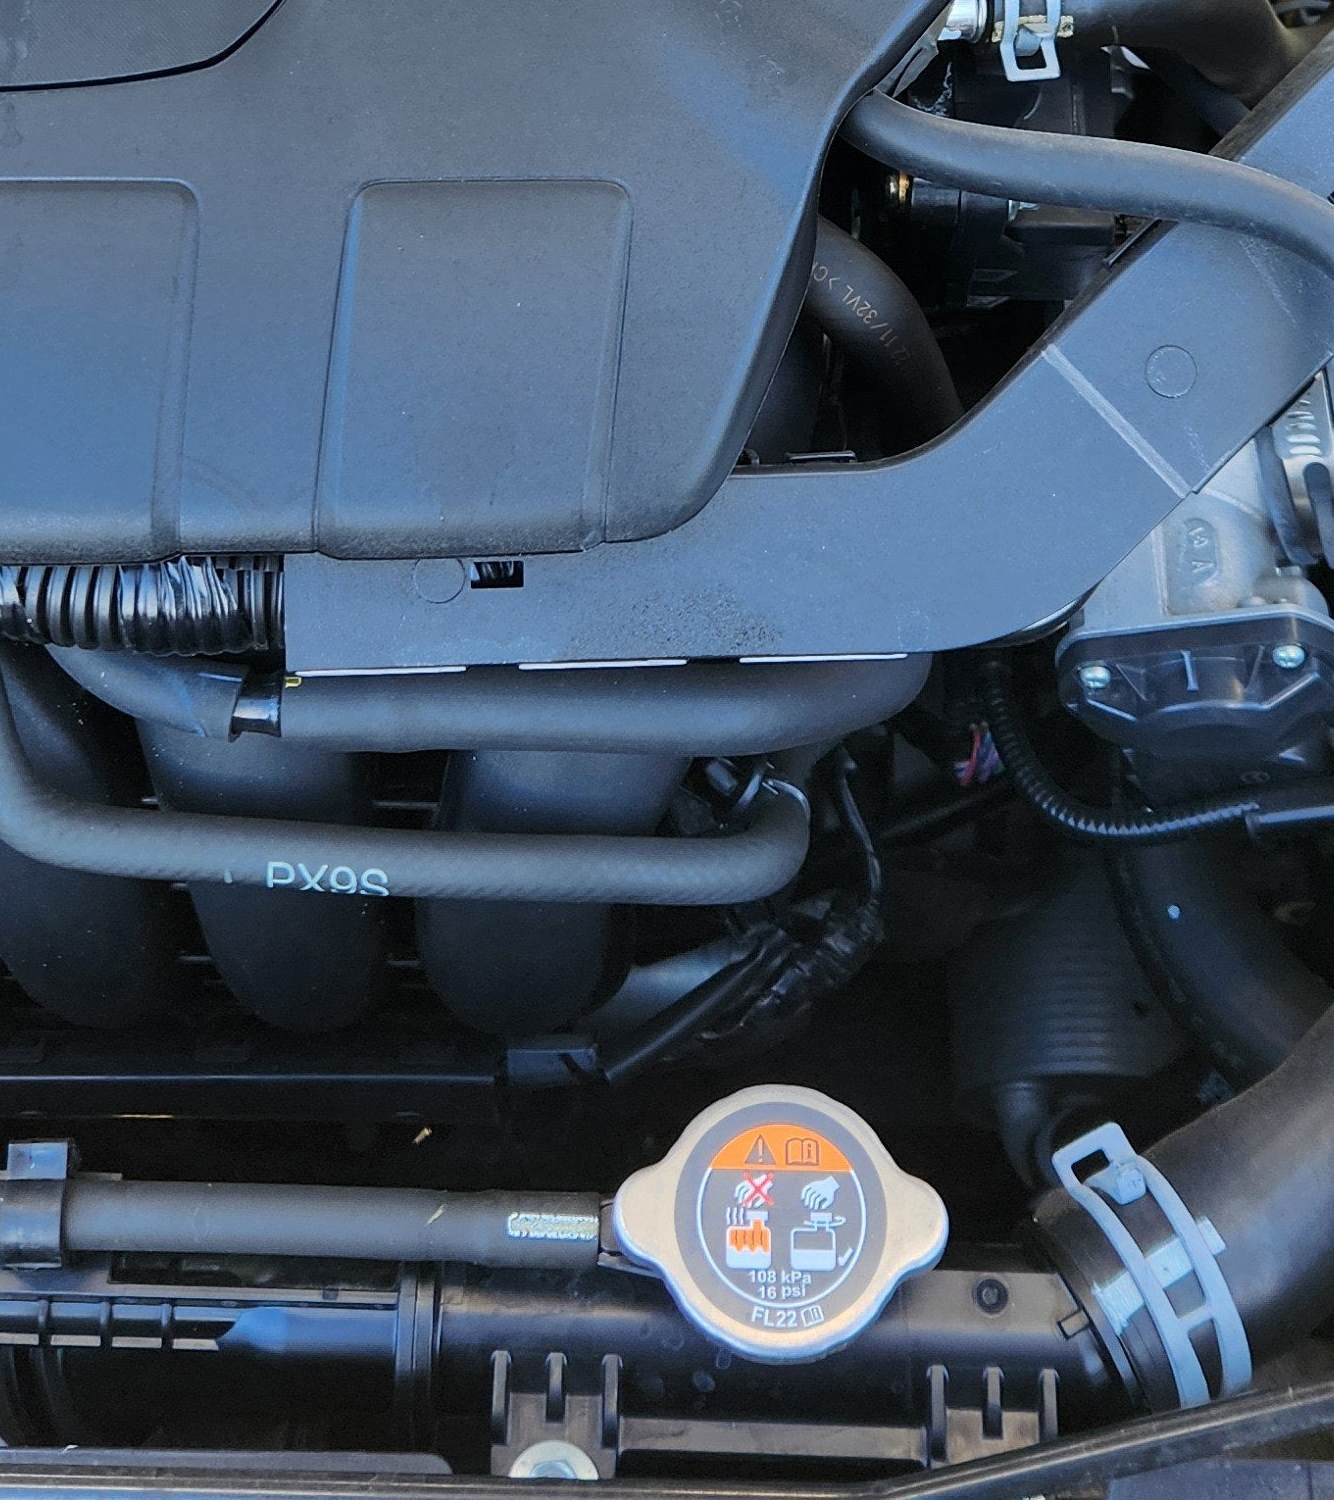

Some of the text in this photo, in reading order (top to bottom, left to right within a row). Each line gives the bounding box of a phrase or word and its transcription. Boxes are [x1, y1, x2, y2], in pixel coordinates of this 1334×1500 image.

[748, 1269, 811, 1285] 108 kPa
[758, 1284, 806, 1300] 16 psi
[751, 1306, 798, 1328] FL22
